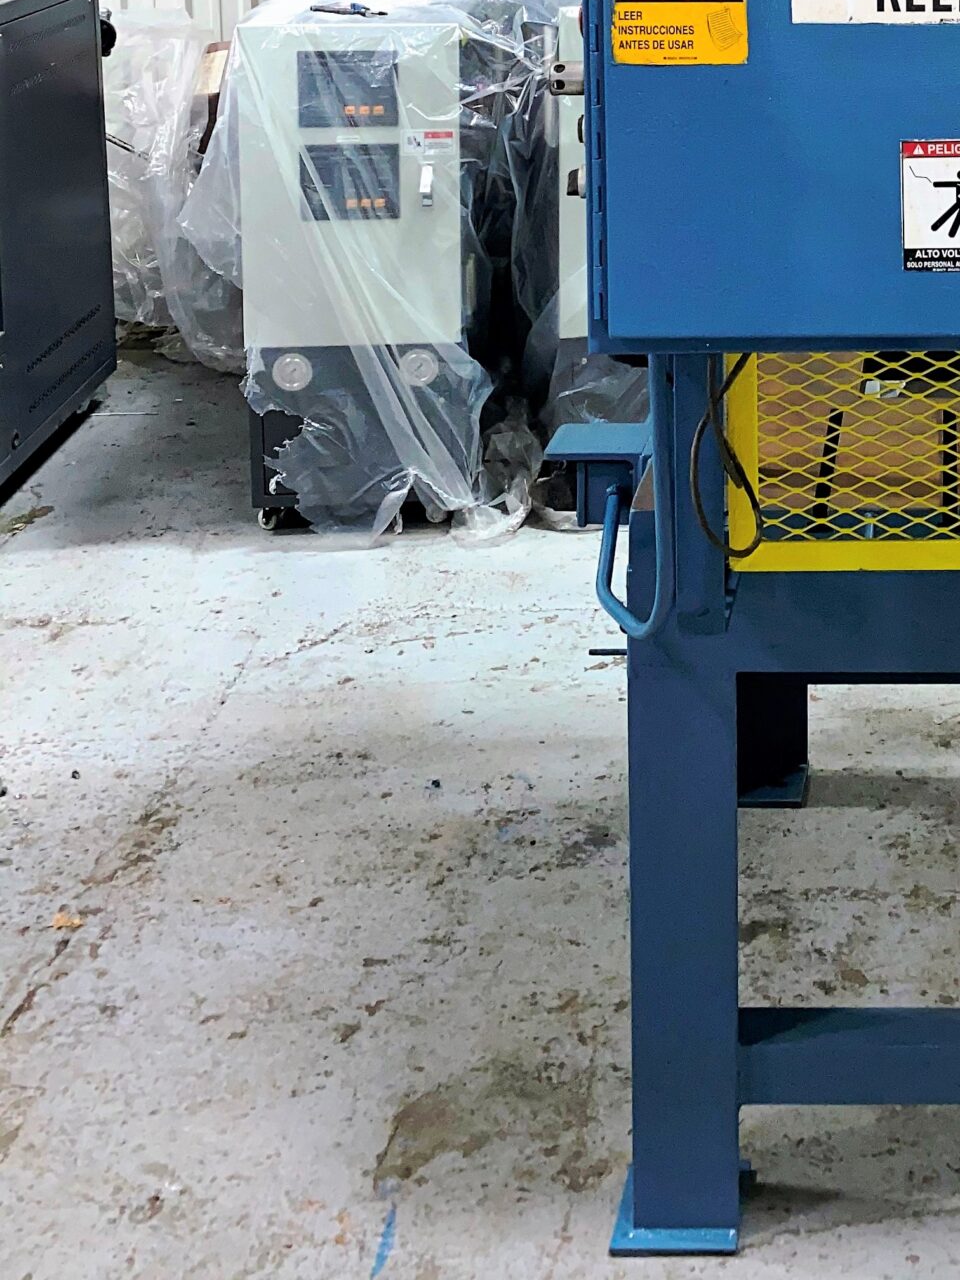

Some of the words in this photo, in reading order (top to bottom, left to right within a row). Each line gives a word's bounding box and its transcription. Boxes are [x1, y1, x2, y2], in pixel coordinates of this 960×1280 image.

[618, 11, 643, 21] LEER
[618, 25, 695, 35] INSTRUCCIONES
[619, 40, 650, 50] ANTES
[652, 40, 665, 49] DE
[668, 40, 694, 50] USAR
[915, 249, 940, 258] ALTO
